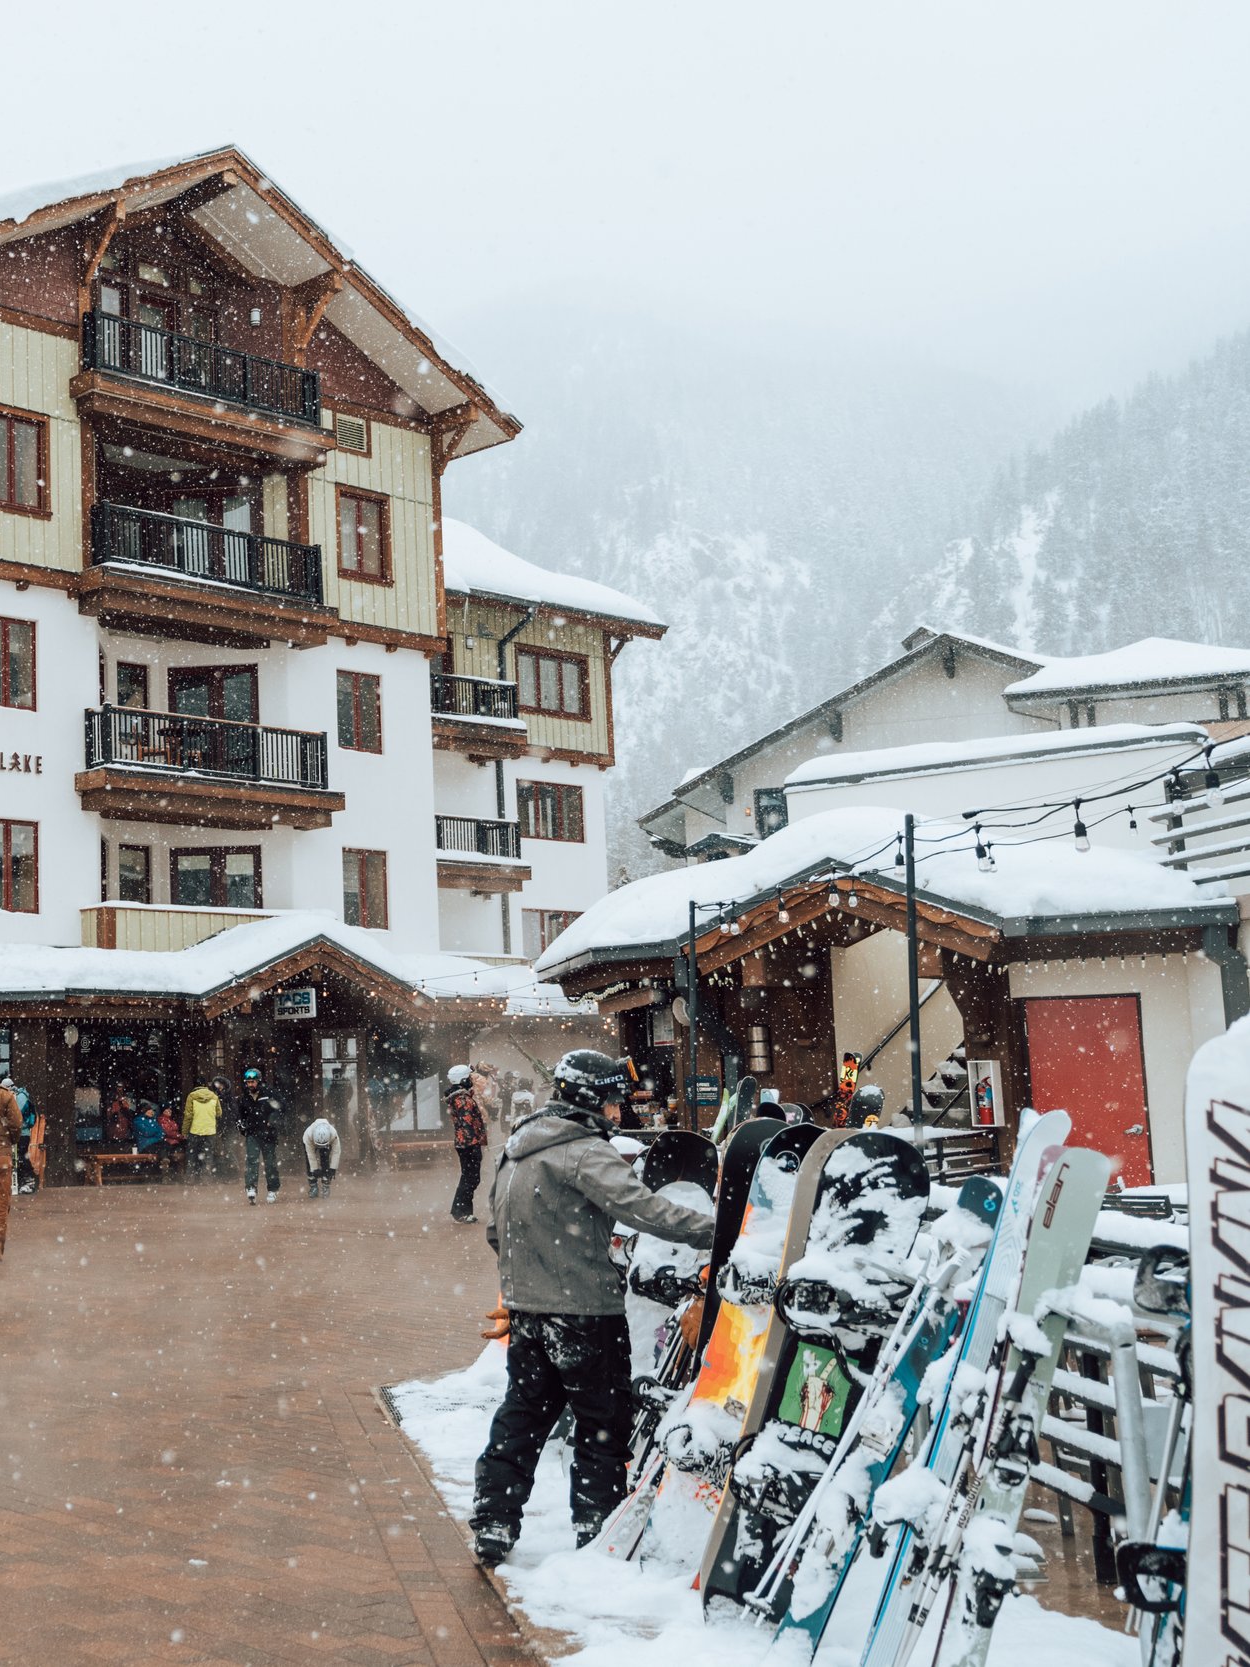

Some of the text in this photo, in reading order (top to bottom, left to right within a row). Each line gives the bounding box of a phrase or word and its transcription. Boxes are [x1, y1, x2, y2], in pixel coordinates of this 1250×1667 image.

[277, 1006, 310, 1016] SPORTS
[594, 1074, 624, 1086] GIRO
[1042, 1162, 1071, 1230] elan
[777, 1423, 837, 1456] PEACE
